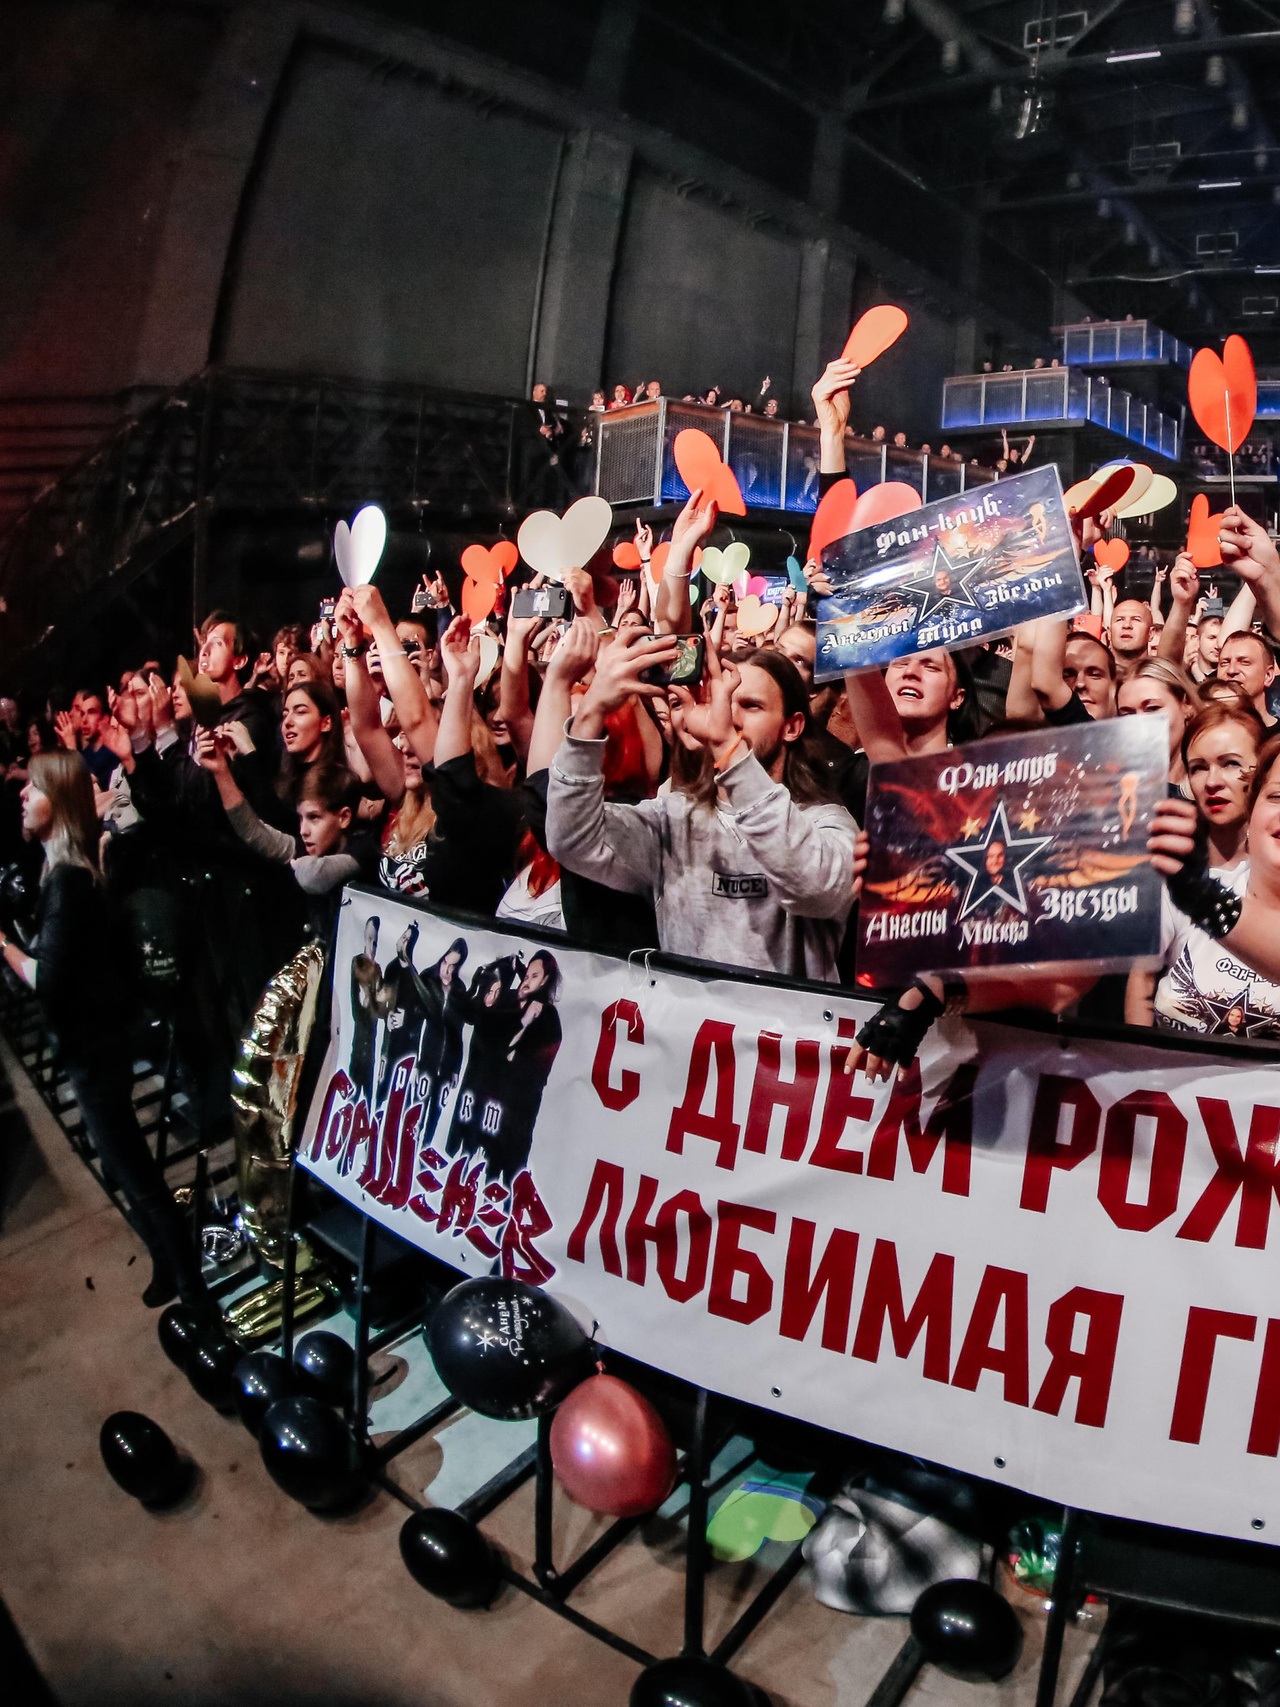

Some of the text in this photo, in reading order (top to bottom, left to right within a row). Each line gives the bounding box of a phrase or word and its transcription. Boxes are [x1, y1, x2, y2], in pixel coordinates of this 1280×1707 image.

[937, 752, 1059, 797] Фан-клуб
[717, 877, 763, 894] NUCE
[1035, 885, 1139, 924] Звезды
[958, 919, 1029, 950] Москва
[591, 998, 645, 1113] С
[566, 1158, 1126, 1429] ЛЮБИМАЯ
